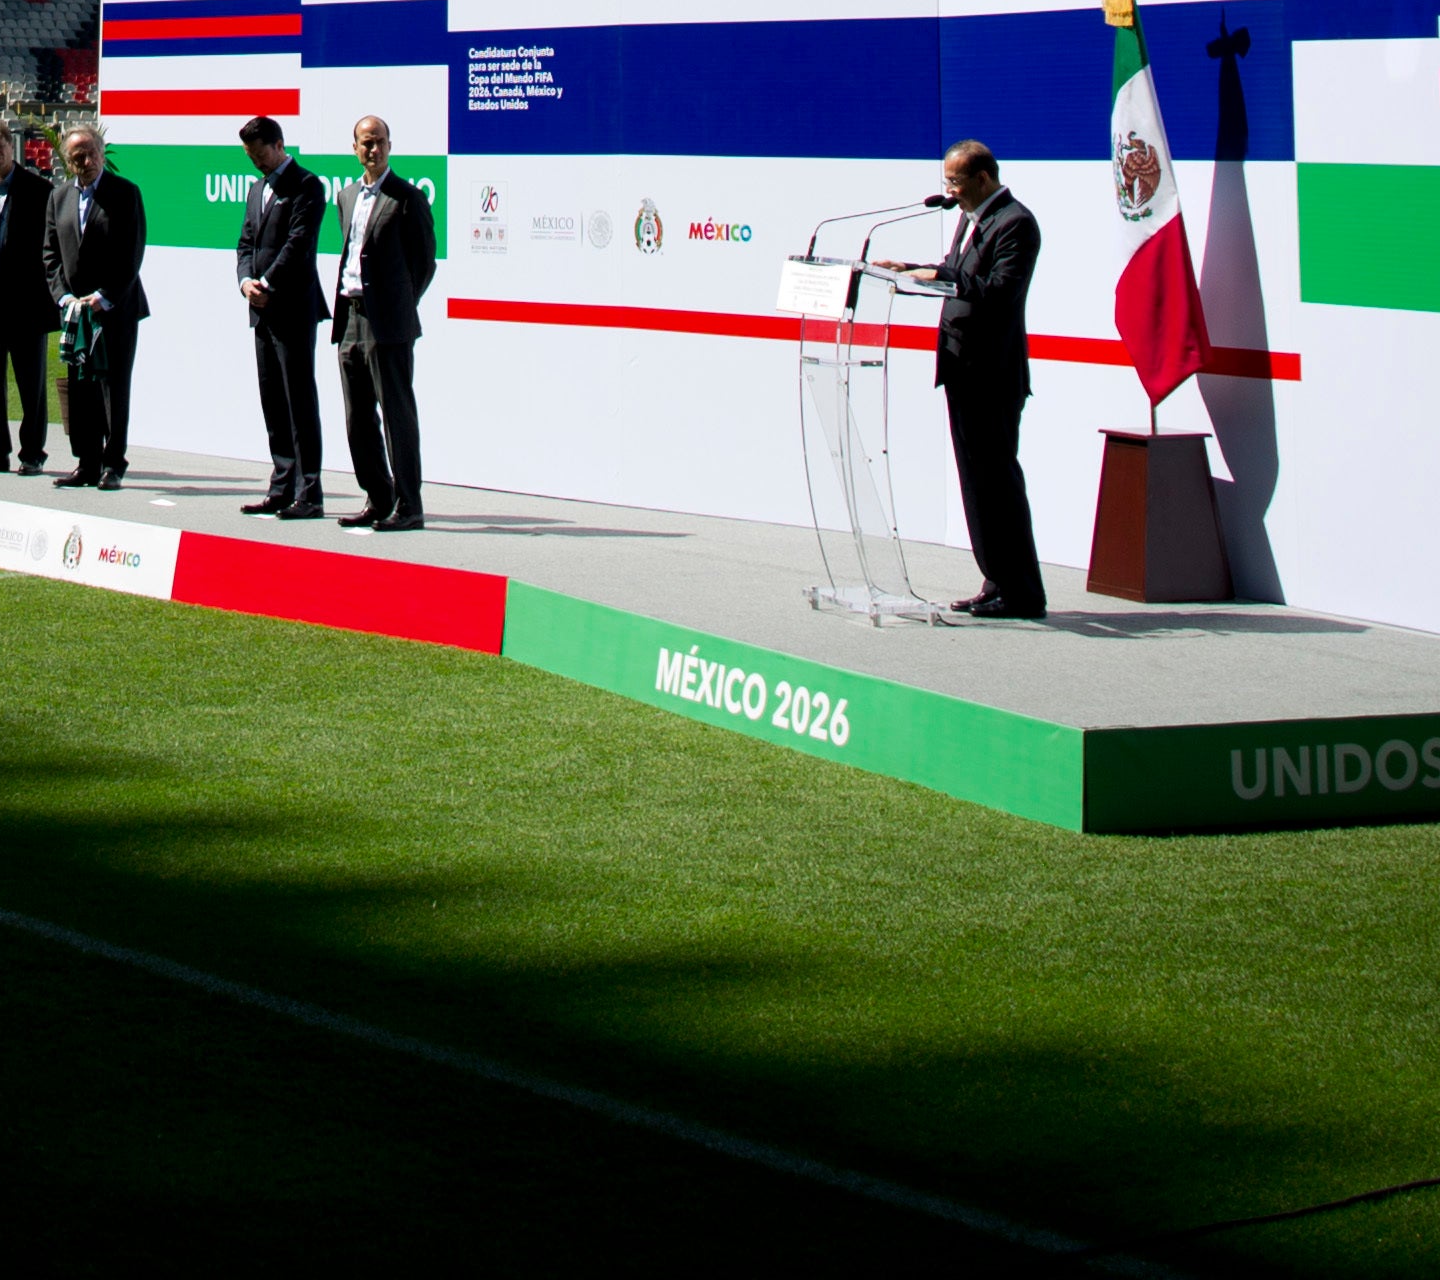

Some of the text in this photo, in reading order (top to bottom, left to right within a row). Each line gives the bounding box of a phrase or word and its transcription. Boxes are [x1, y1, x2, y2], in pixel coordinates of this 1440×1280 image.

[468, 46, 555, 60] Candidatura Conjunta
[468, 59, 542, 74] para ser sede de la
[468, 72, 554, 87] Copa del Mundo FIFA
[468, 85, 563, 99] 2026. Canadá, México y
[468, 98, 529, 111] Estados Unidos
[532, 214, 574, 230] MÉXICO
[655, 644, 850, 747] MÉXICO 2026
